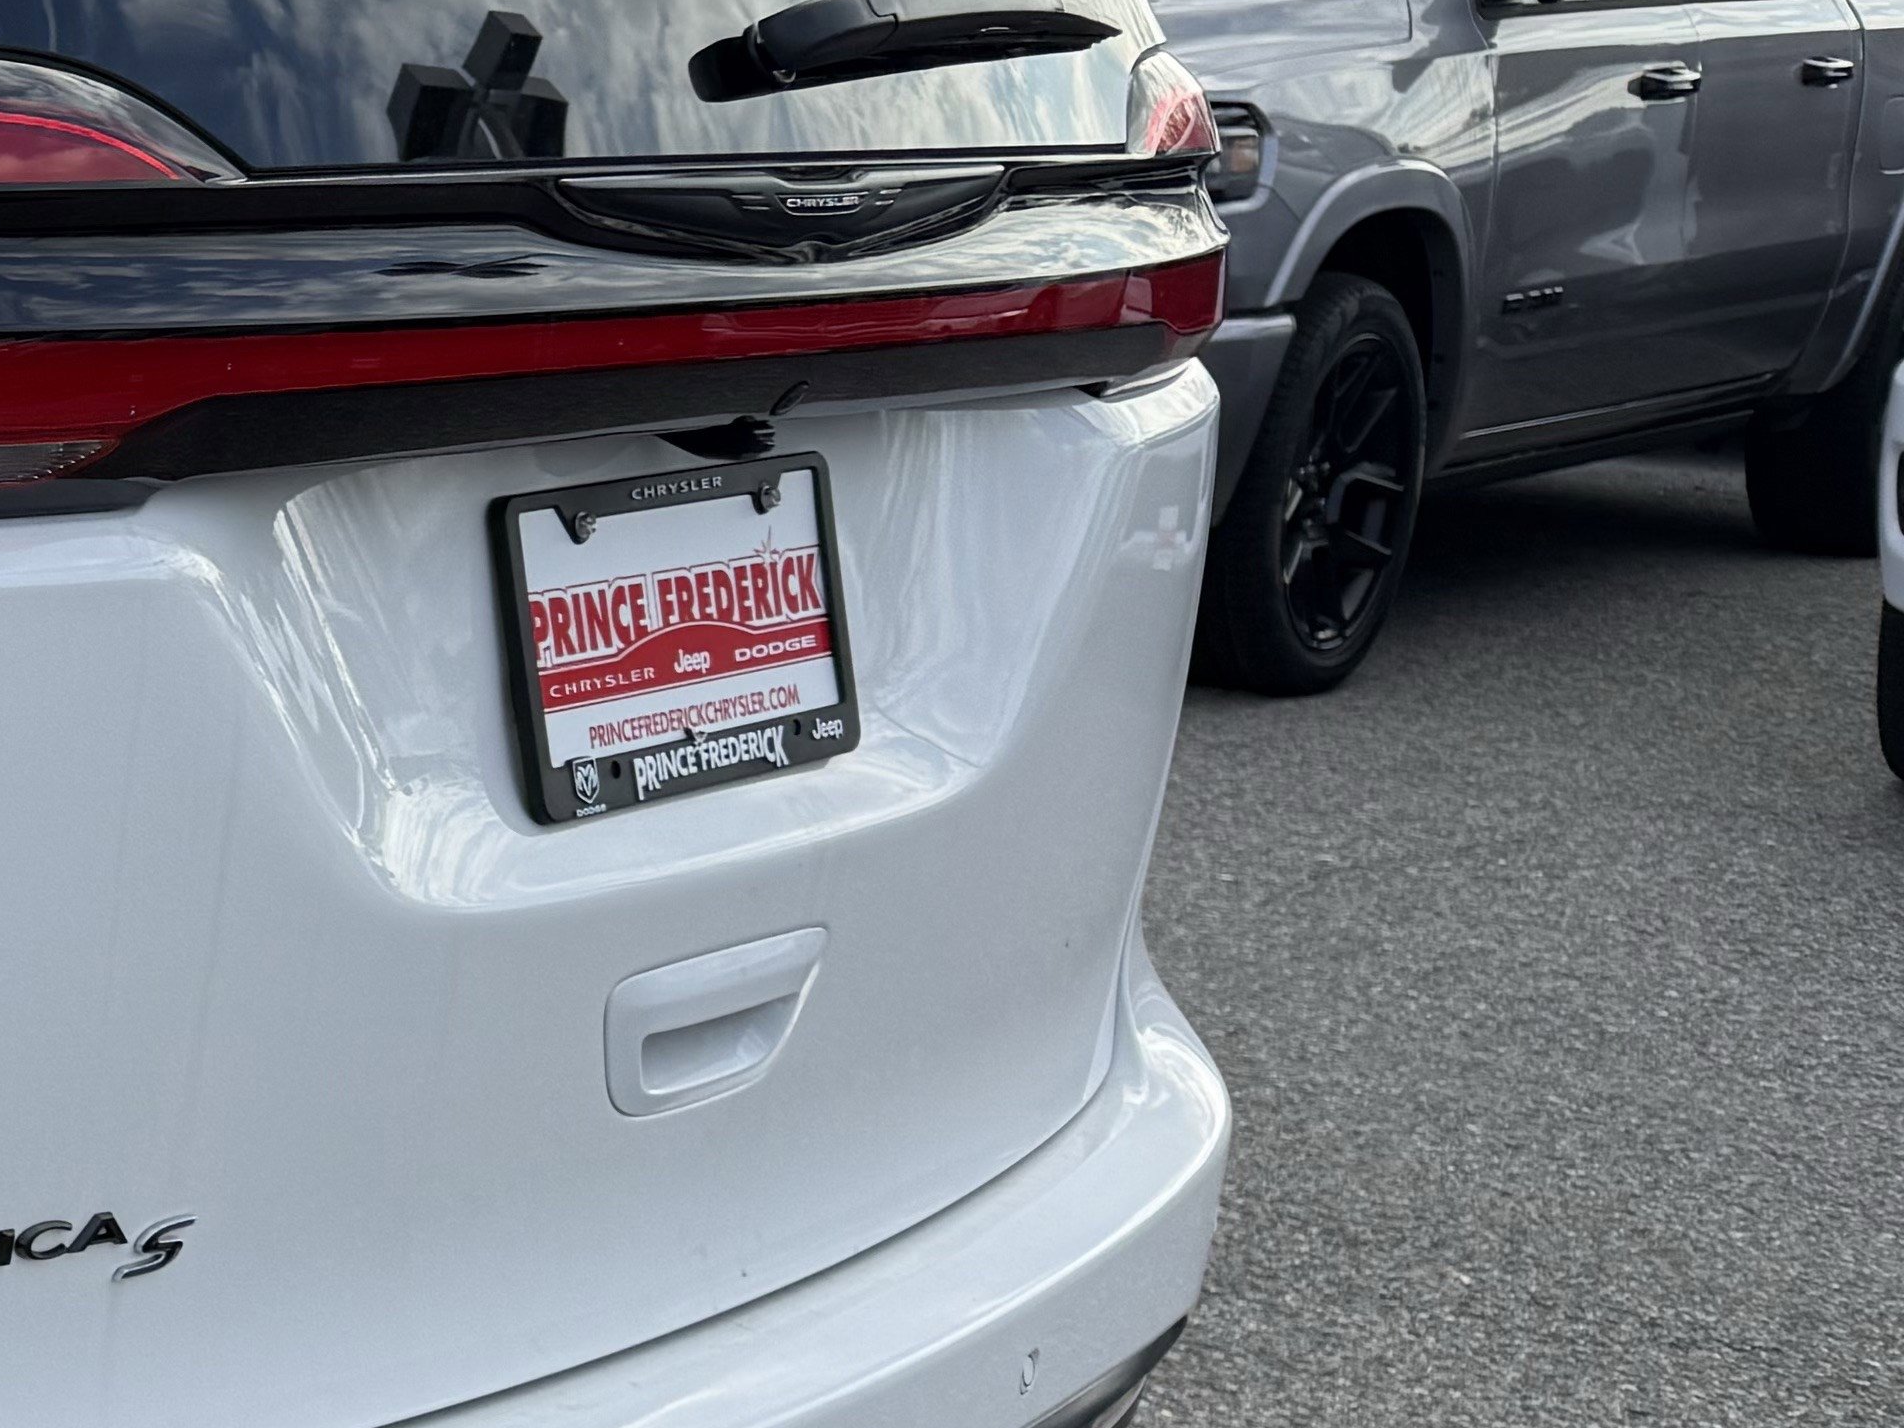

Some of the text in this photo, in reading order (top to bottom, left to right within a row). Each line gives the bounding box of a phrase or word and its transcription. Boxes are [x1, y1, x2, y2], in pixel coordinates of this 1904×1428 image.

[786, 196, 860, 208] CHRYSLER
[631, 475, 722, 500] CHRYSLER
[528, 552, 822, 662] PRINCE FREDERICK
[548, 634, 818, 699] CHRYSLER Jeep DODGE
[588, 683, 801, 750] PRINCEFREDERICKCHRYSLER.COM
[811, 717, 844, 741] Jeep
[632, 724, 790, 802] PRINCE FREDERICK
[575, 803, 608, 817] DODGE
[110, 1212, 200, 1283] S
